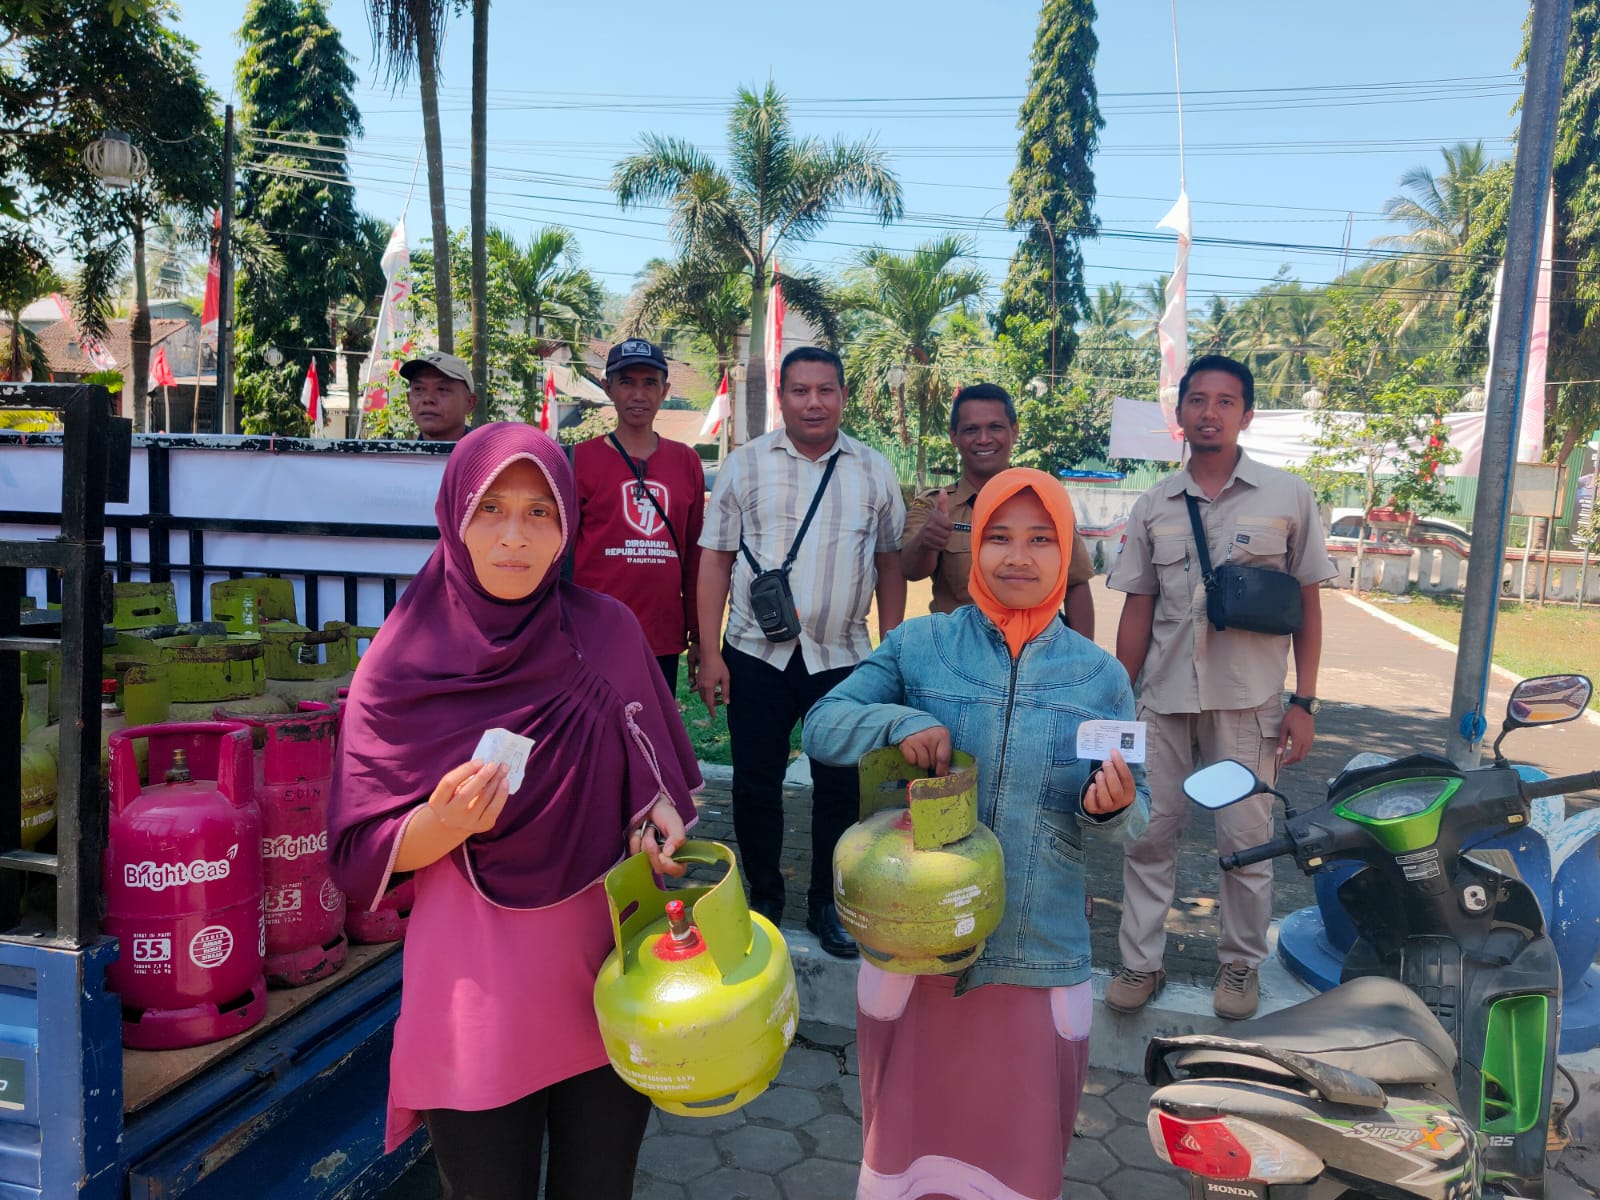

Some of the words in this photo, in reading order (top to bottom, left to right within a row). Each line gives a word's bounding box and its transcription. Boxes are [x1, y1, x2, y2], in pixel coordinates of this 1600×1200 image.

[605, 548, 647, 556] REPUBLIK
[263, 834, 317, 860] Bright
[124, 861, 188, 891] Bright
[187, 860, 230, 883] Gas
[1489, 1136, 1515, 1147] 125
[1207, 1183, 1258, 1198] HONDA
